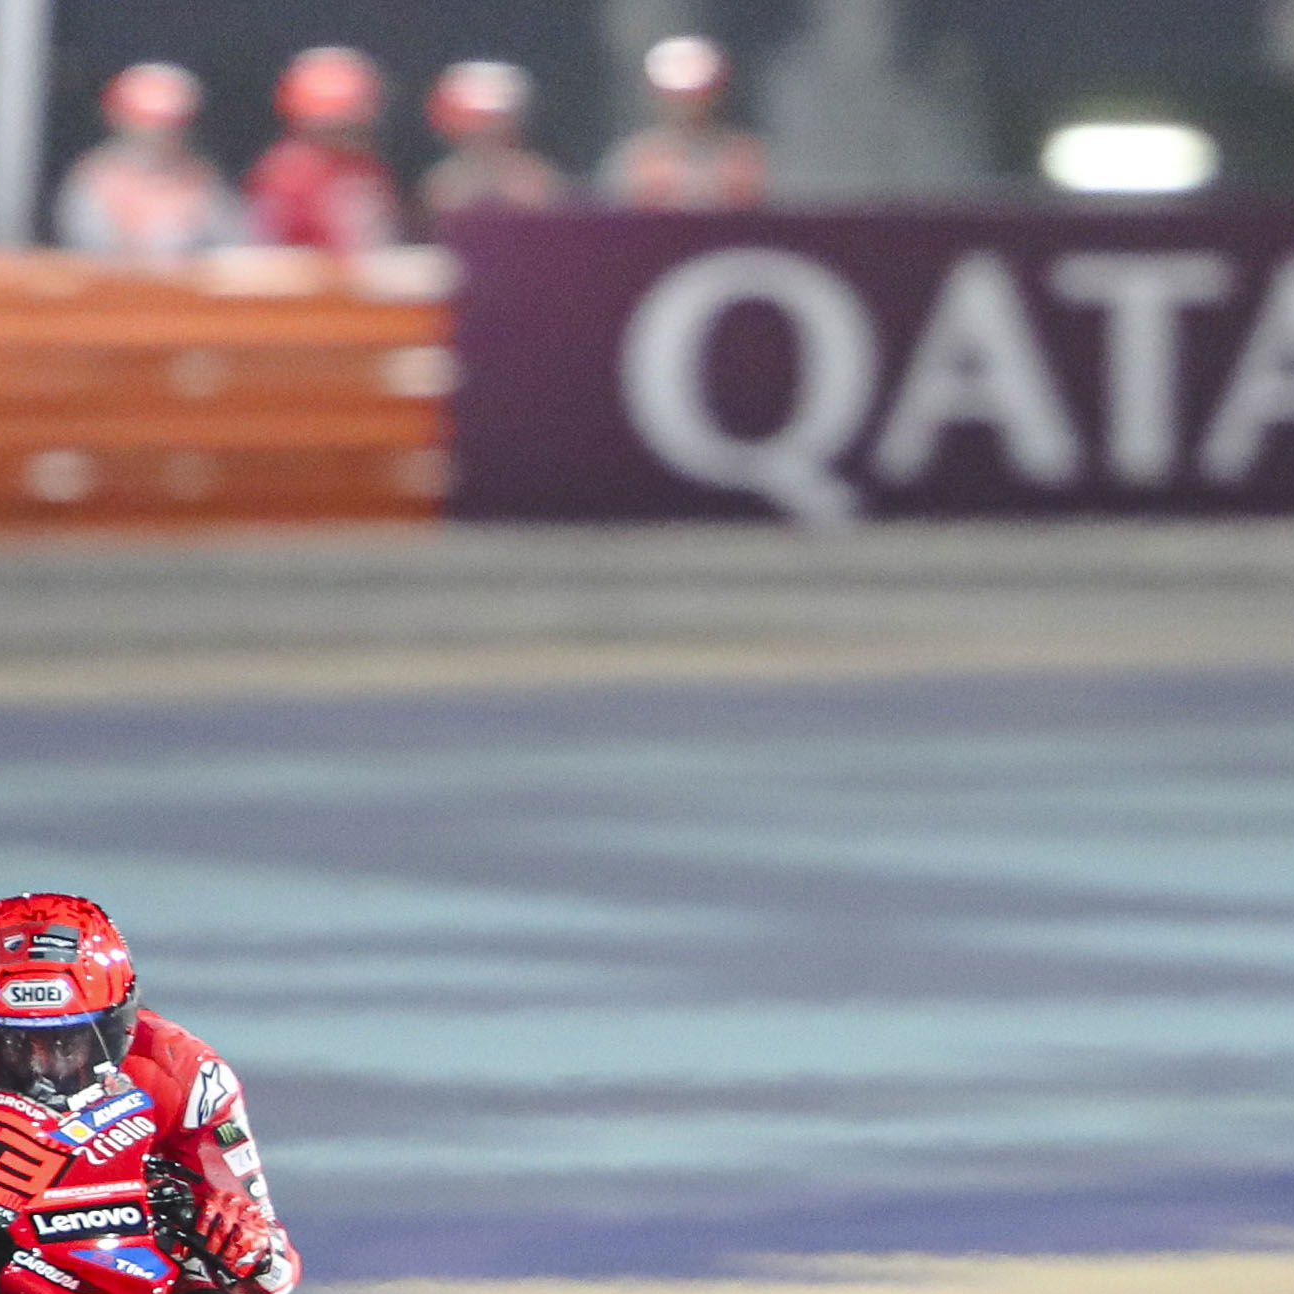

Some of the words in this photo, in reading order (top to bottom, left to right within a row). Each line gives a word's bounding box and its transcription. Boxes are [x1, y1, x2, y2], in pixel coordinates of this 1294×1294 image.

[12, 986, 62, 1003] SHOEI
[32, 1206, 142, 1236] Lenovo
[12, 1250, 81, 1291] CARRERA
[115, 1257, 155, 1280] TIM
